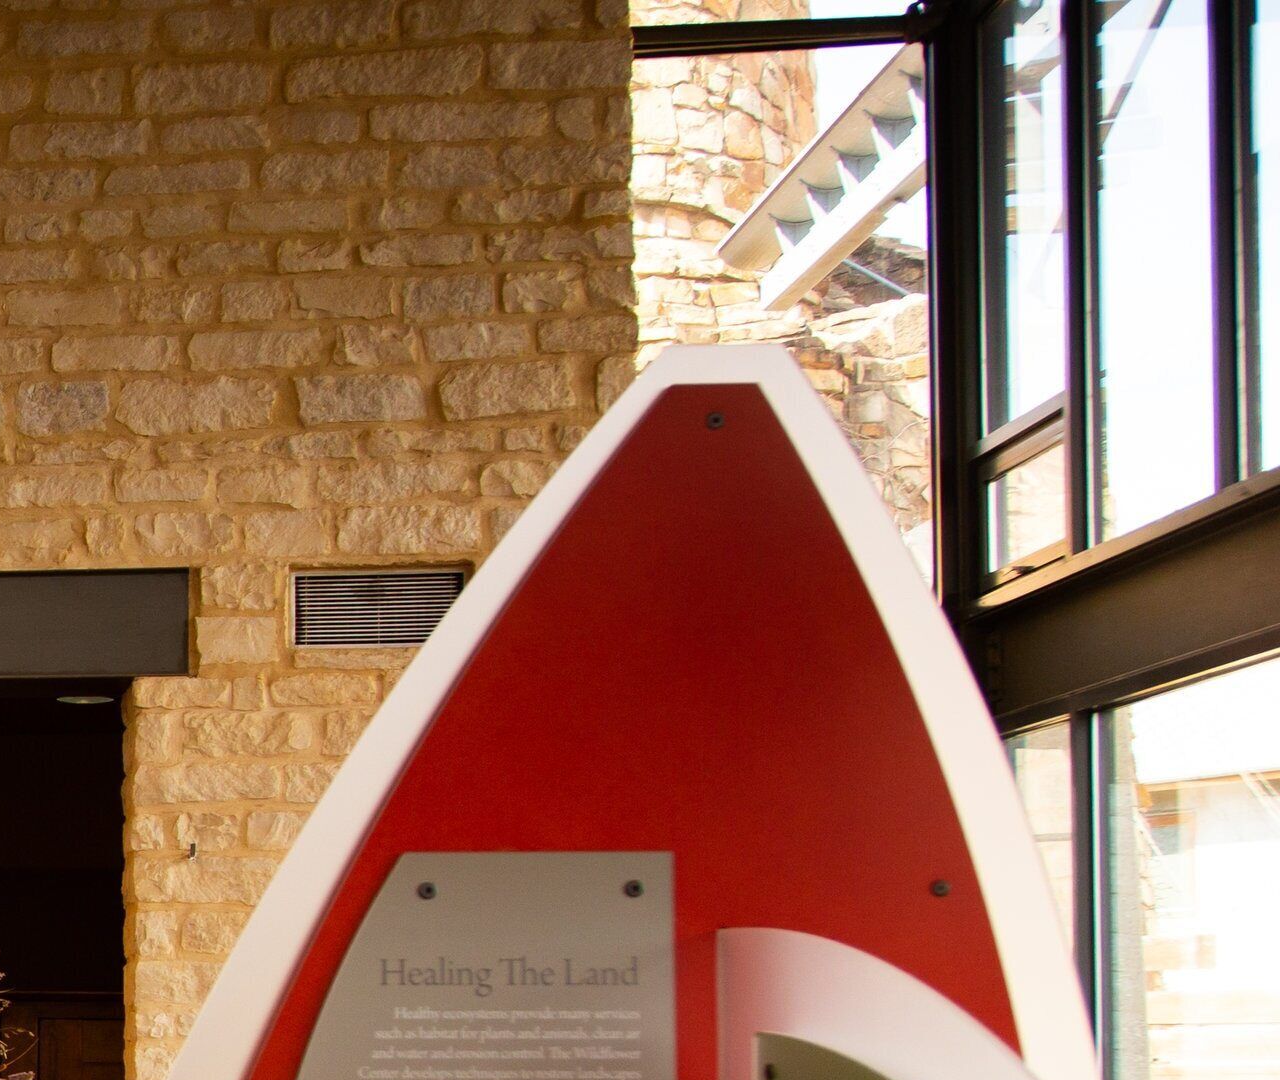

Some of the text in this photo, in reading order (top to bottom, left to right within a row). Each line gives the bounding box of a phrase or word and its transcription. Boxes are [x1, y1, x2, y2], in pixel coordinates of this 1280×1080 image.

[380, 956, 639, 997] Healing The Land
[394, 1006, 641, 1023] Healthy ecosystems provide many services
[548, 1046, 571, 1059] The
[572, 1046, 642, 1060] Wildflower
[356, 1066, 399, 1080] Center
